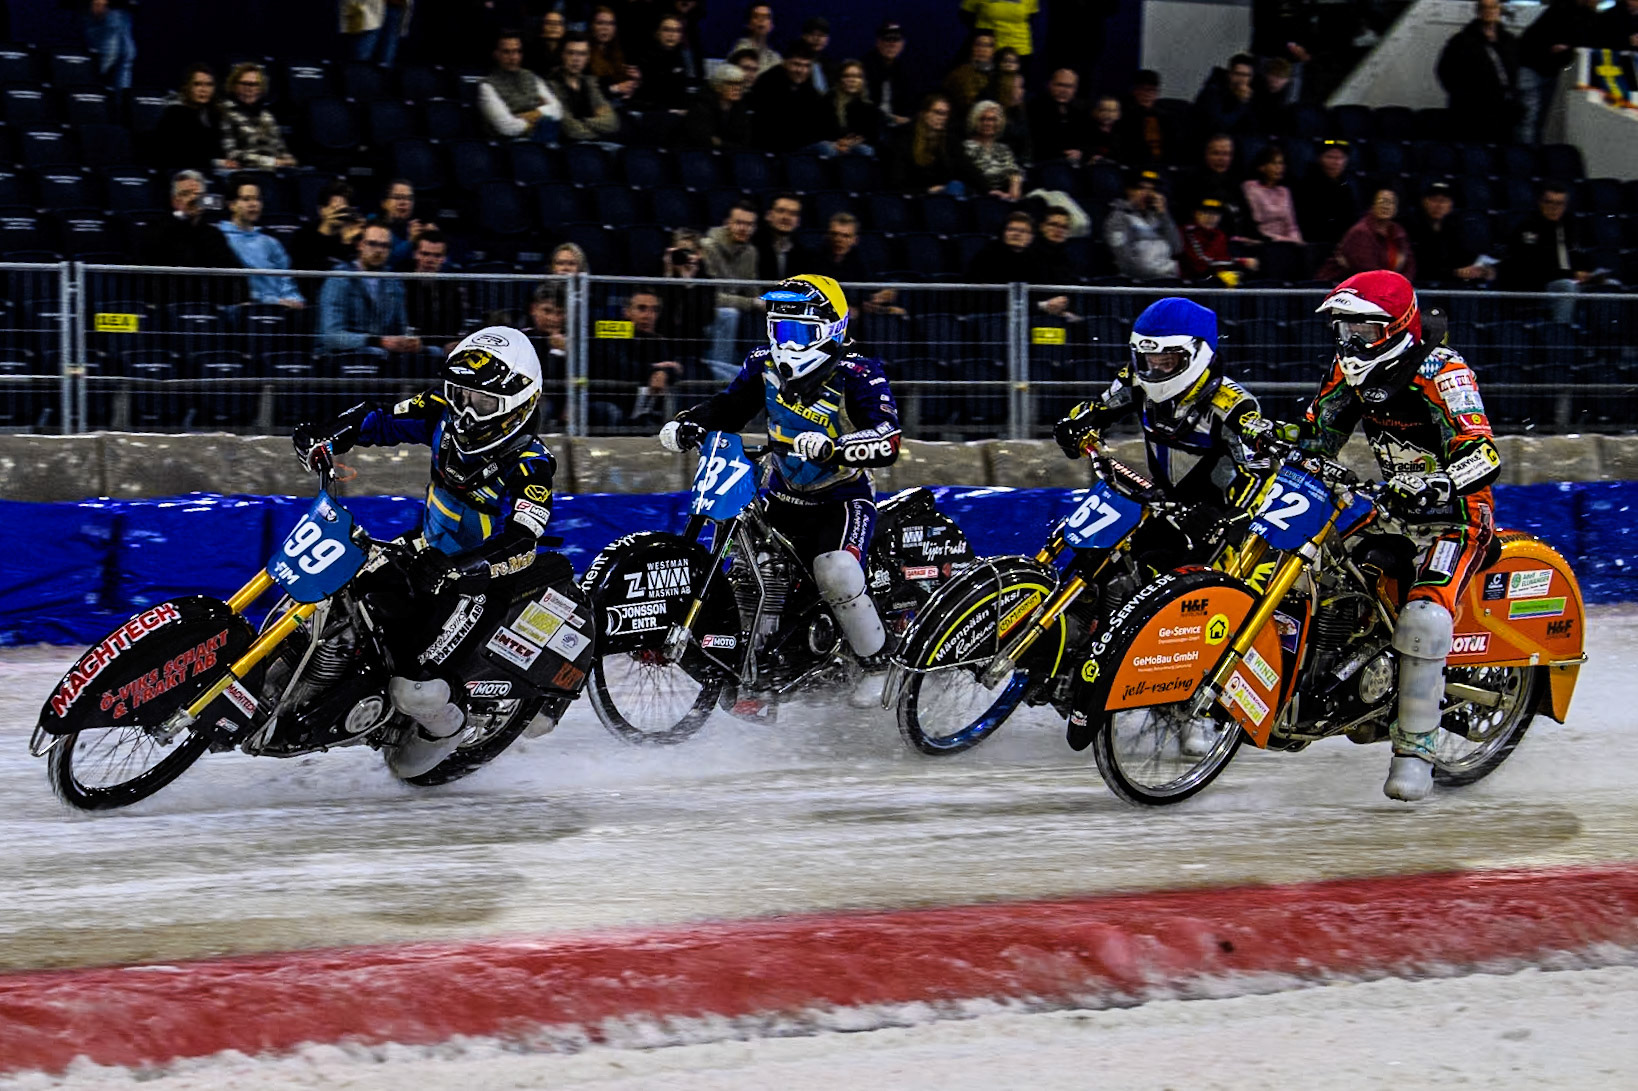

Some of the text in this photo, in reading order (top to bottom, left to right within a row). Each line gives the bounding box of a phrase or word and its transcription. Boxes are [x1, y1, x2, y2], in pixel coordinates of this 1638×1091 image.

[1068, 494, 1121, 538] 67
[646, 558, 690, 571] WESTMAN
[274, 561, 300, 586] FIM
[648, 586, 692, 599] MASKIN AB
[621, 602, 667, 619] JONSSON
[1181, 598, 1209, 613] H&F
[632, 616, 657, 630] ENTR
[713, 637, 736, 647] MOTO
[49, 602, 183, 718] MACHTECH
[163, 629, 229, 677] SCHAKT
[1173, 650, 1199, 664] GmbH
[113, 652, 217, 719] & FRAKT AB
